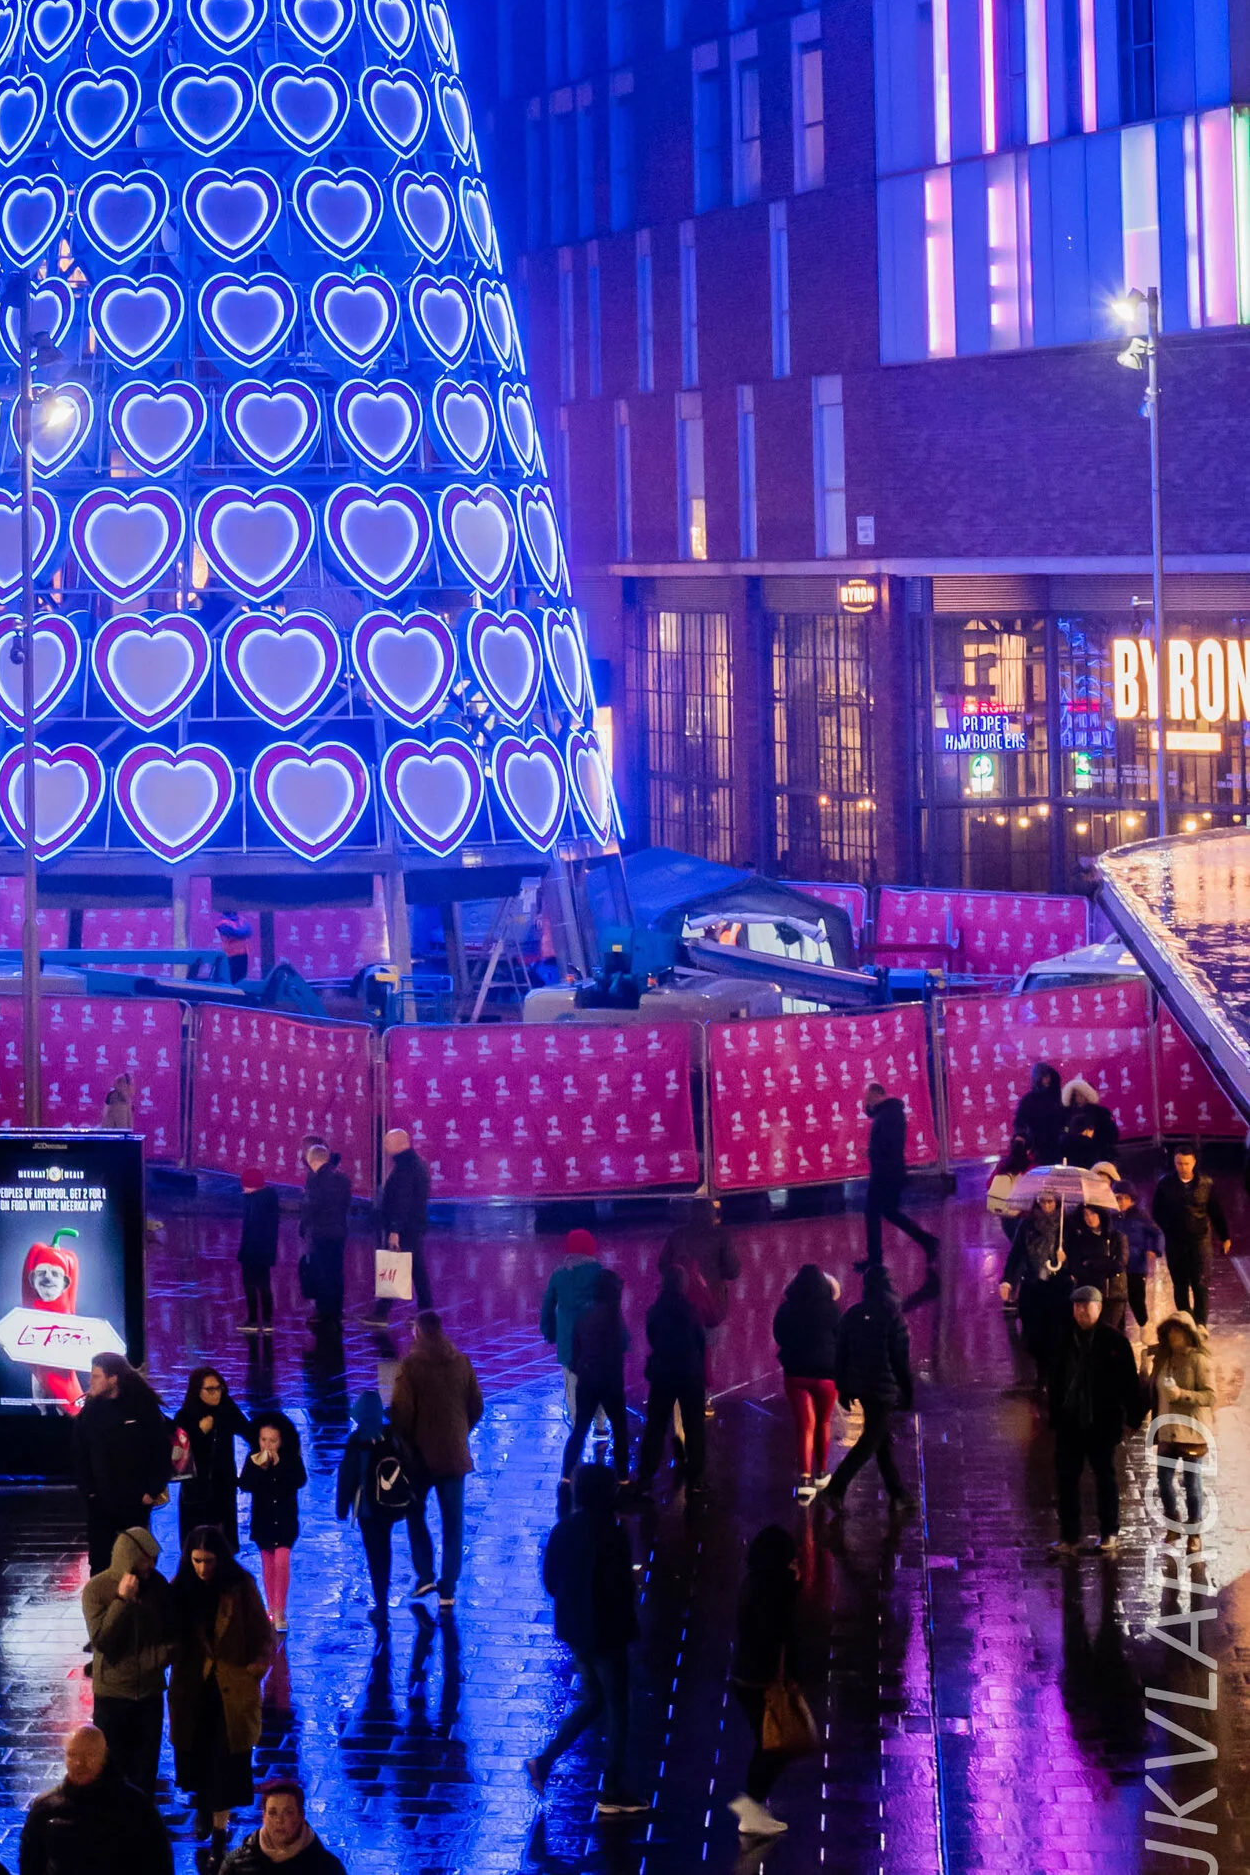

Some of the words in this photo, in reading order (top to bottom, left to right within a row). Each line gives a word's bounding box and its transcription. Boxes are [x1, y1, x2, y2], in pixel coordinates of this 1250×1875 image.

[840, 586, 875, 603] BYRON
[962, 715, 1010, 731] PROPER
[945, 732, 1026, 750] HAMBURGERS
[24, 1187, 33, 1199] OF
[69, 1188, 82, 1200] GET
[89, 1188, 101, 1200] FOR
[11, 1200, 28, 1211] FOOD
[28, 1200, 46, 1211] WITH
[47, 1200, 59, 1212] THE
[60, 1200, 89, 1212] MEERKAT
[90, 1200, 104, 1212] APP
